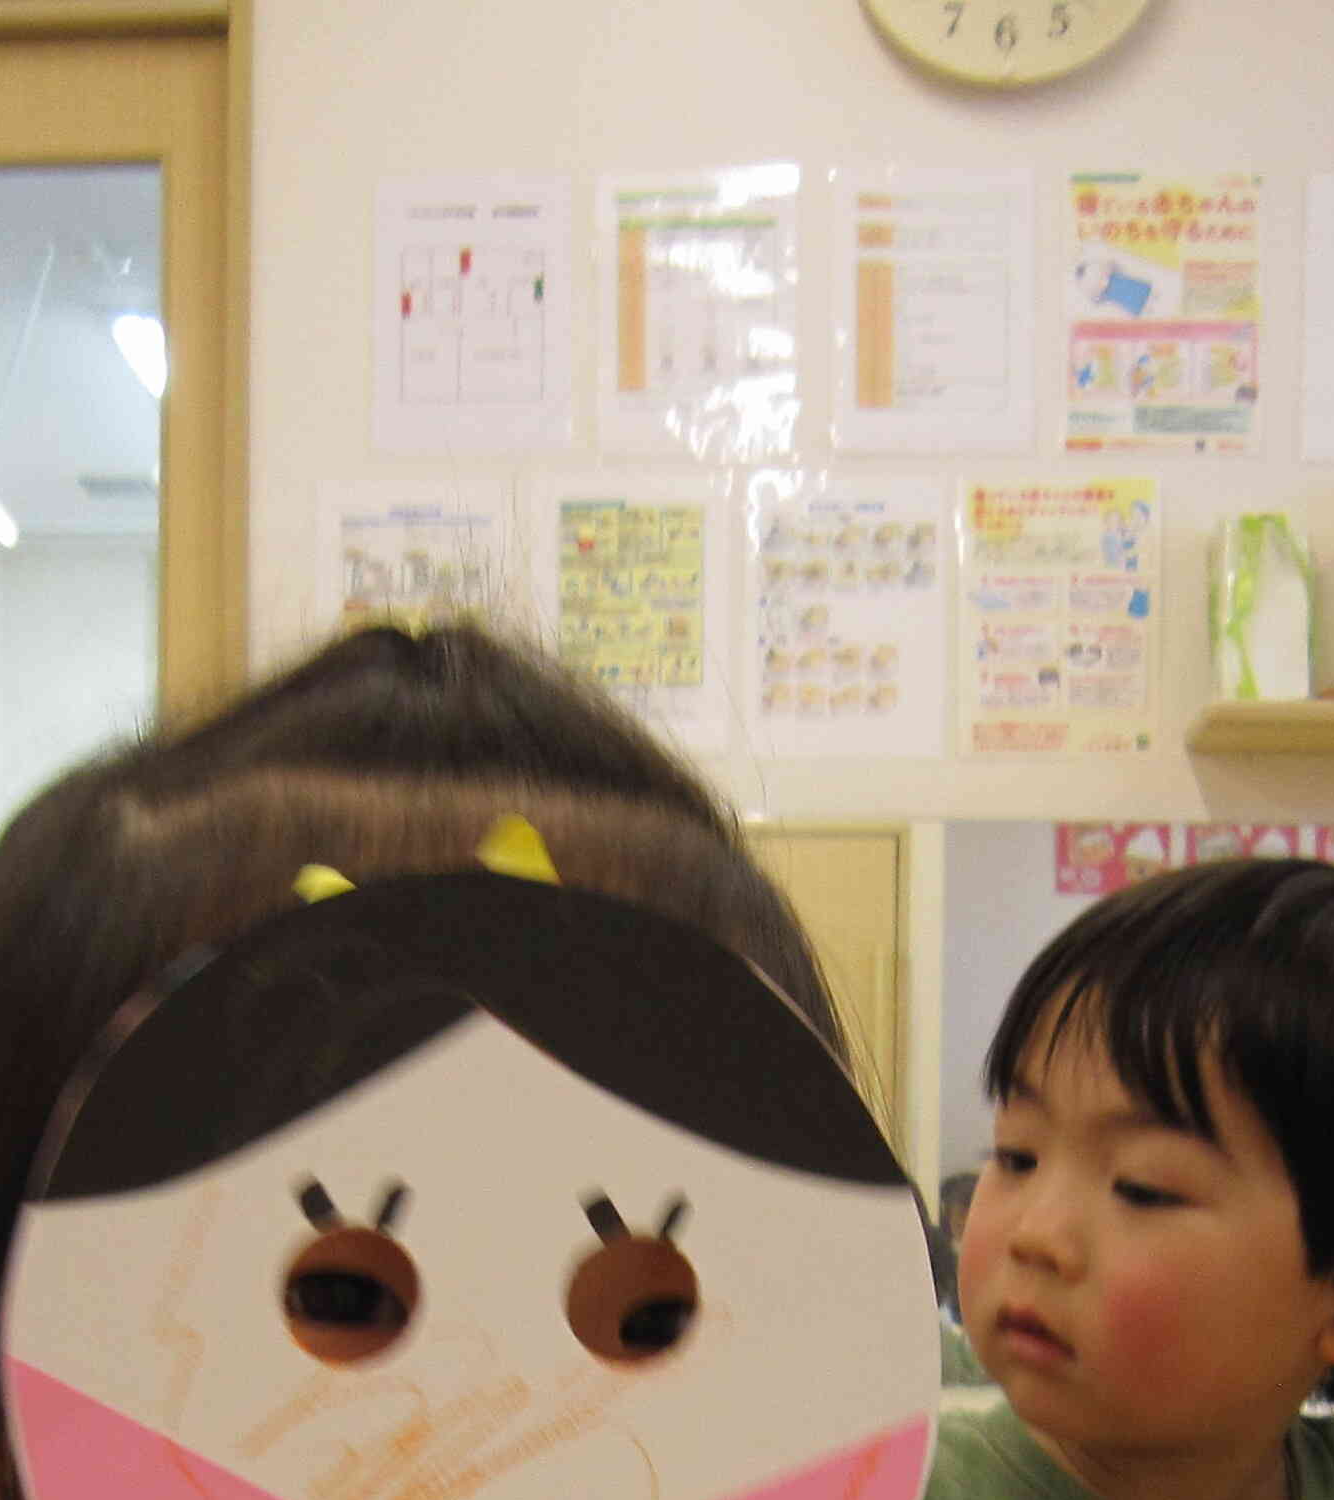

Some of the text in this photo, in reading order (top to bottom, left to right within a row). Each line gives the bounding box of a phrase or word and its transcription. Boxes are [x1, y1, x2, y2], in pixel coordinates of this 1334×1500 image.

[944, 1, 964, 38] 7
[994, 15, 1017, 51] 6
[1049, 3, 1069, 39] 5
